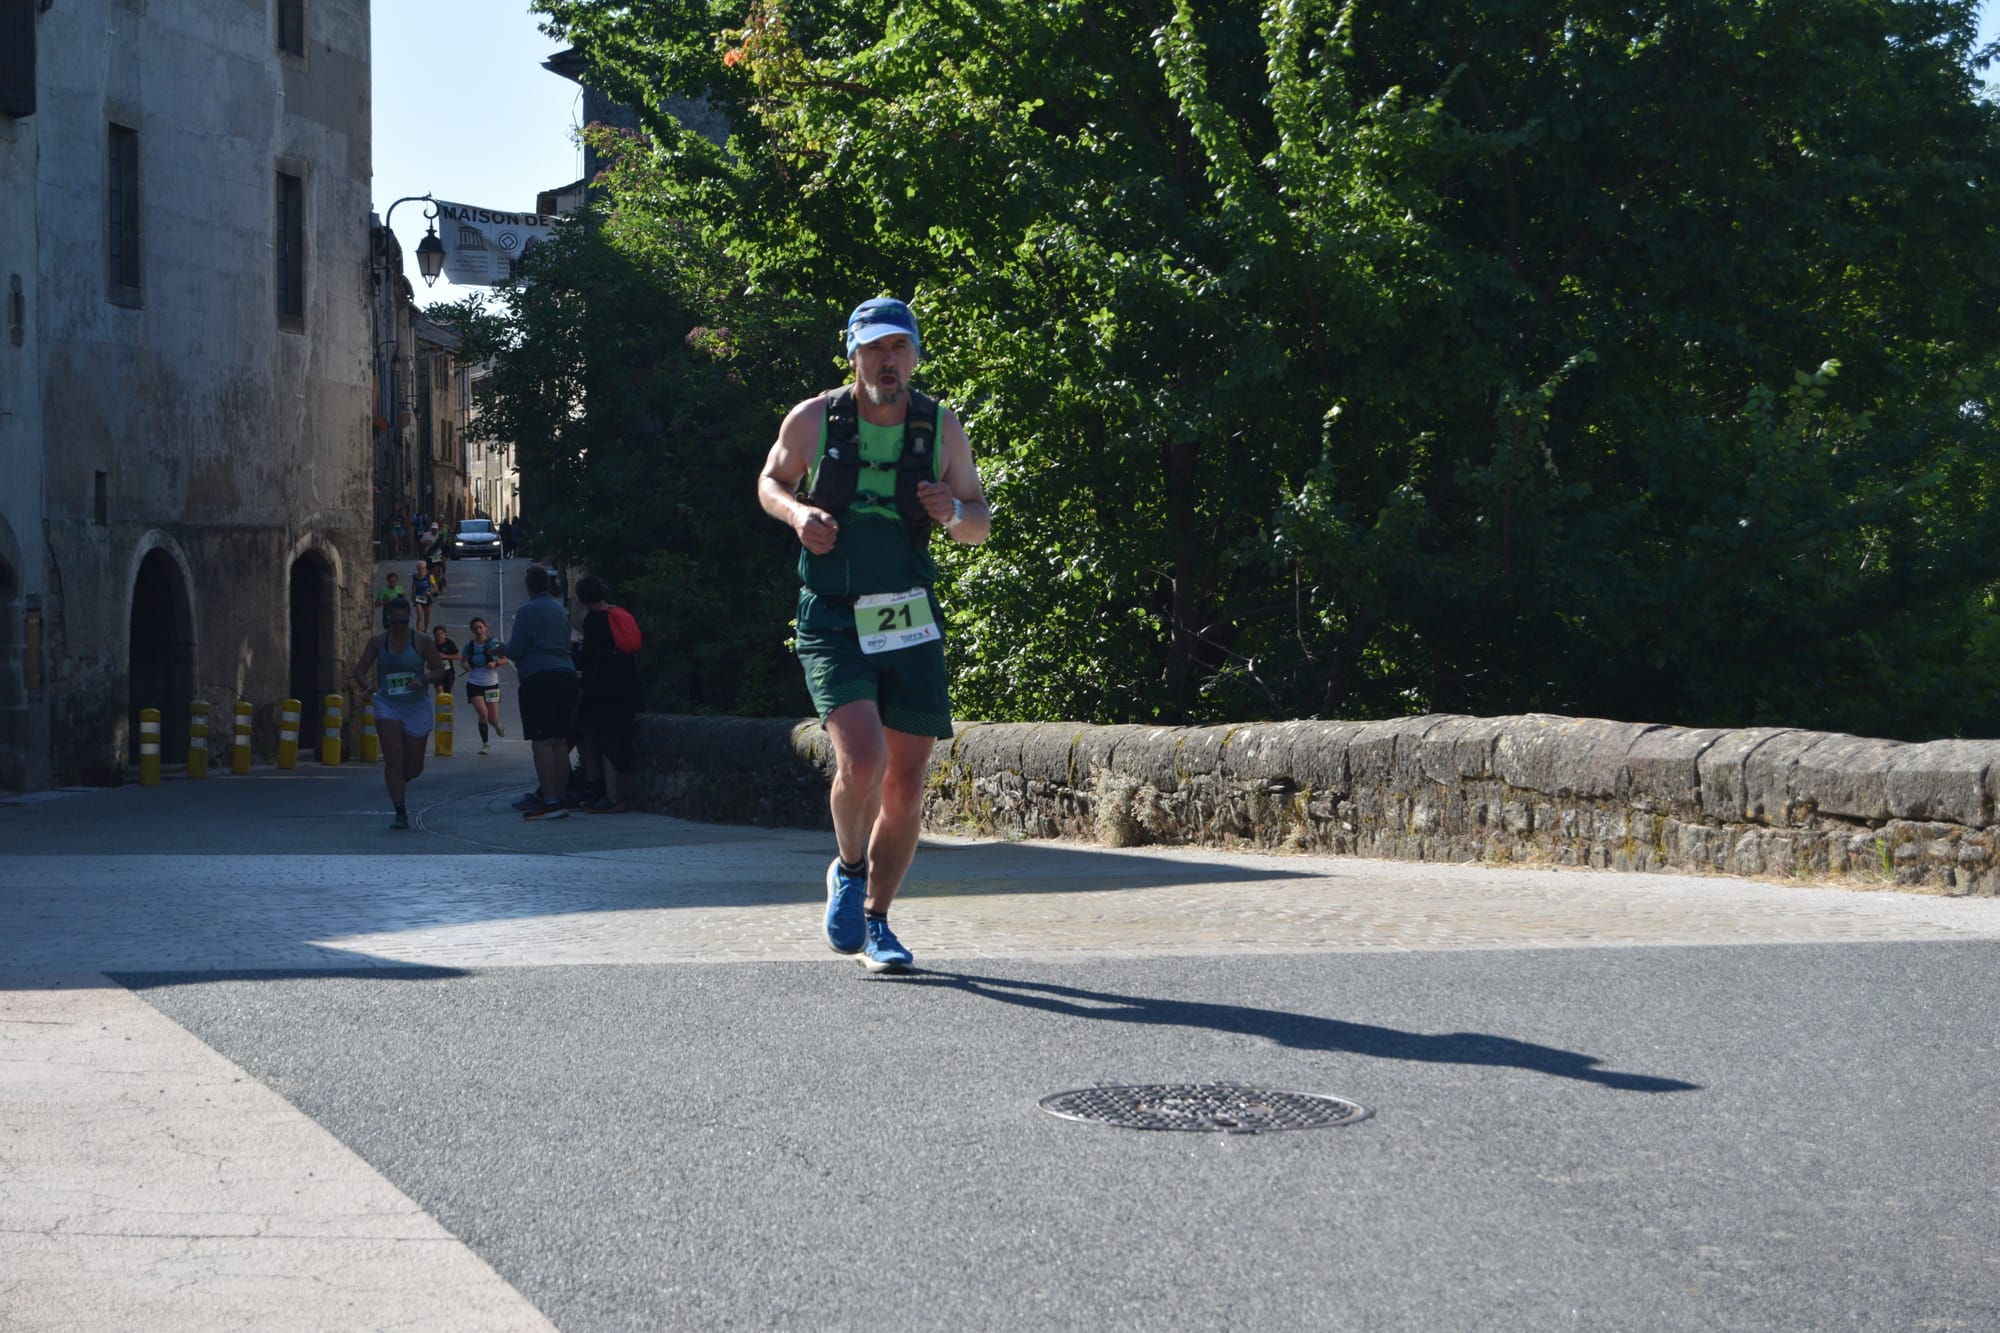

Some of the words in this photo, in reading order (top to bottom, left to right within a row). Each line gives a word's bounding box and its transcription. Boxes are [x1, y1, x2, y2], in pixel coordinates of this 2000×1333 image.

[443, 206, 519, 226] MAISON
[525, 215, 549, 227] DE
[877, 603, 912, 632] 21
